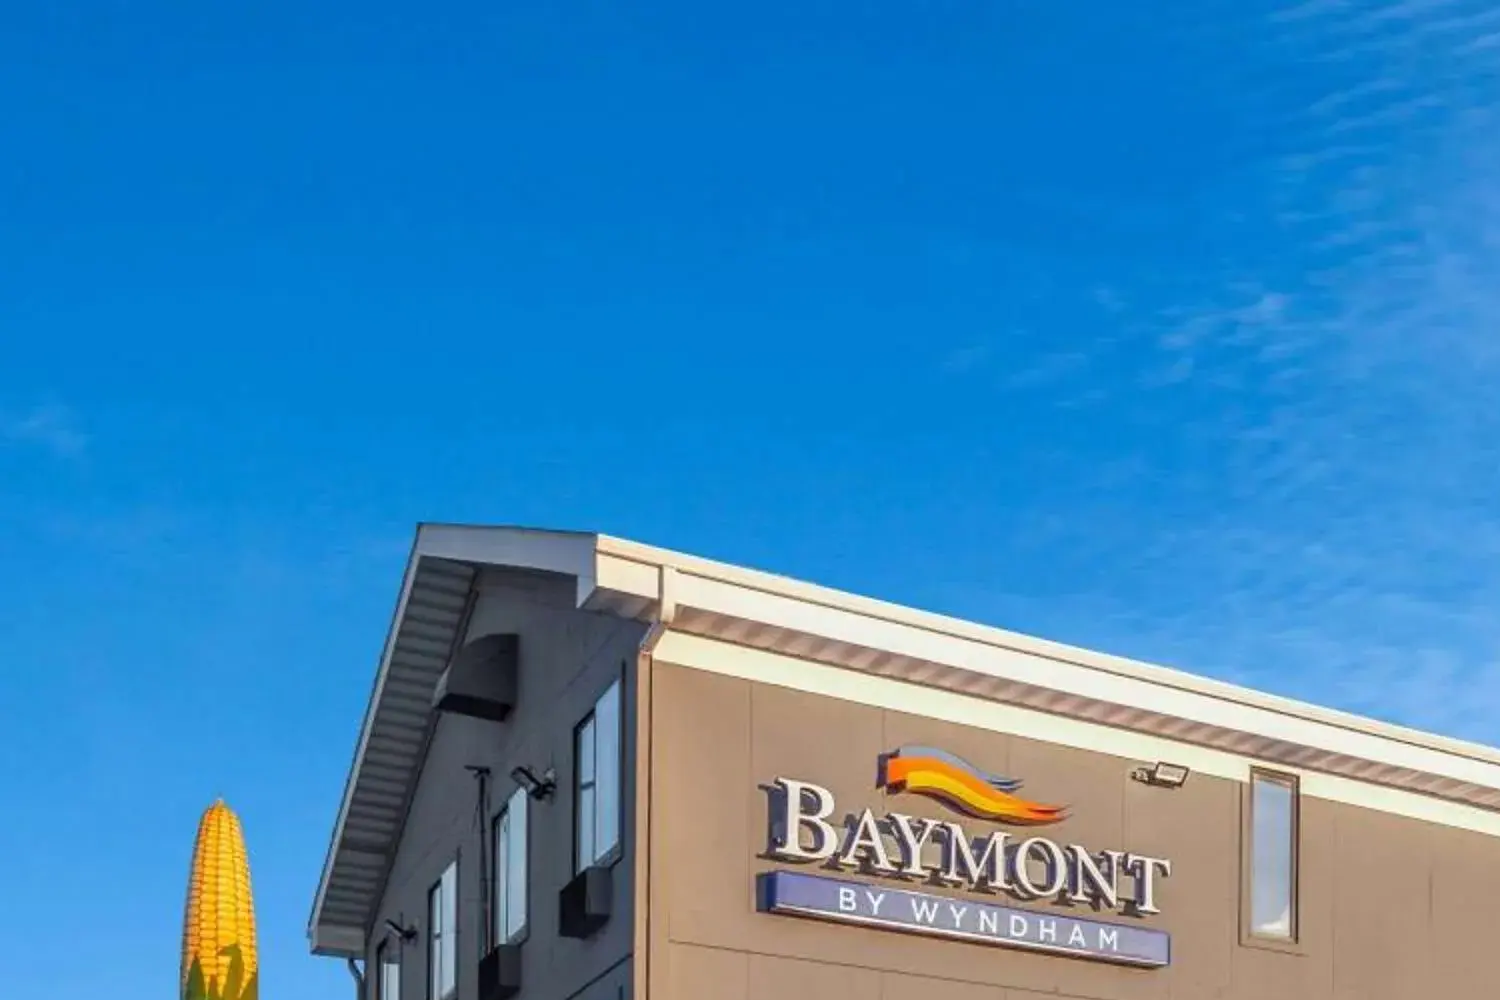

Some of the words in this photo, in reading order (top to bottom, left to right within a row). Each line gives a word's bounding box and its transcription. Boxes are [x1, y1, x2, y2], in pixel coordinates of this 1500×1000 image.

[768, 776, 1172, 915] BAYMONT
[839, 887, 886, 916] BY
[912, 897, 1119, 951] WYNDHAM
